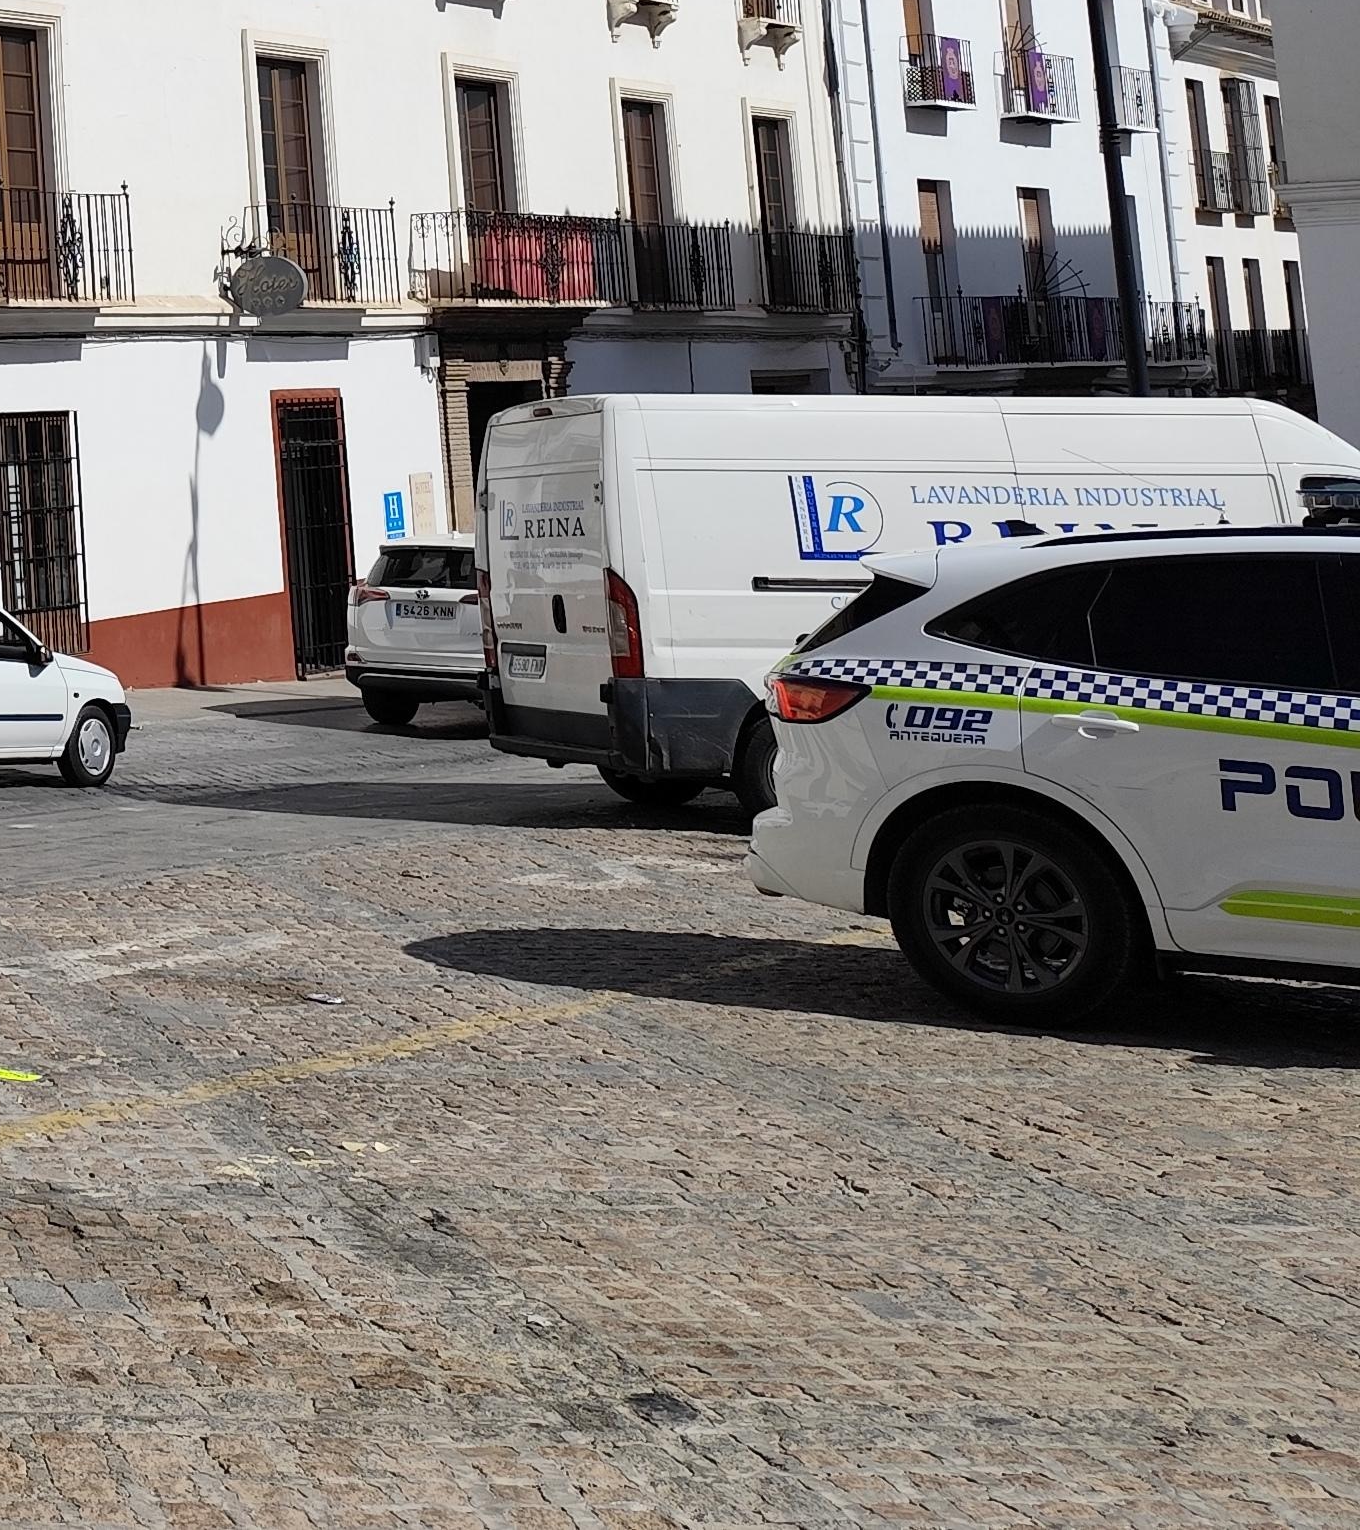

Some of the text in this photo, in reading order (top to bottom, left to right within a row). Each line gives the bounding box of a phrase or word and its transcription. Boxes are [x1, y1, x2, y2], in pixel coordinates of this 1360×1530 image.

[910, 485, 1226, 508] LAVANDERIA INDUSTRIAL
[524, 516, 586, 539] REINA
[404, 605, 454, 618] 5426 KNN
[903, 705, 993, 732] 092
[889, 730, 986, 745] ANTEQUERA
[1219, 758, 1360, 822] PO
